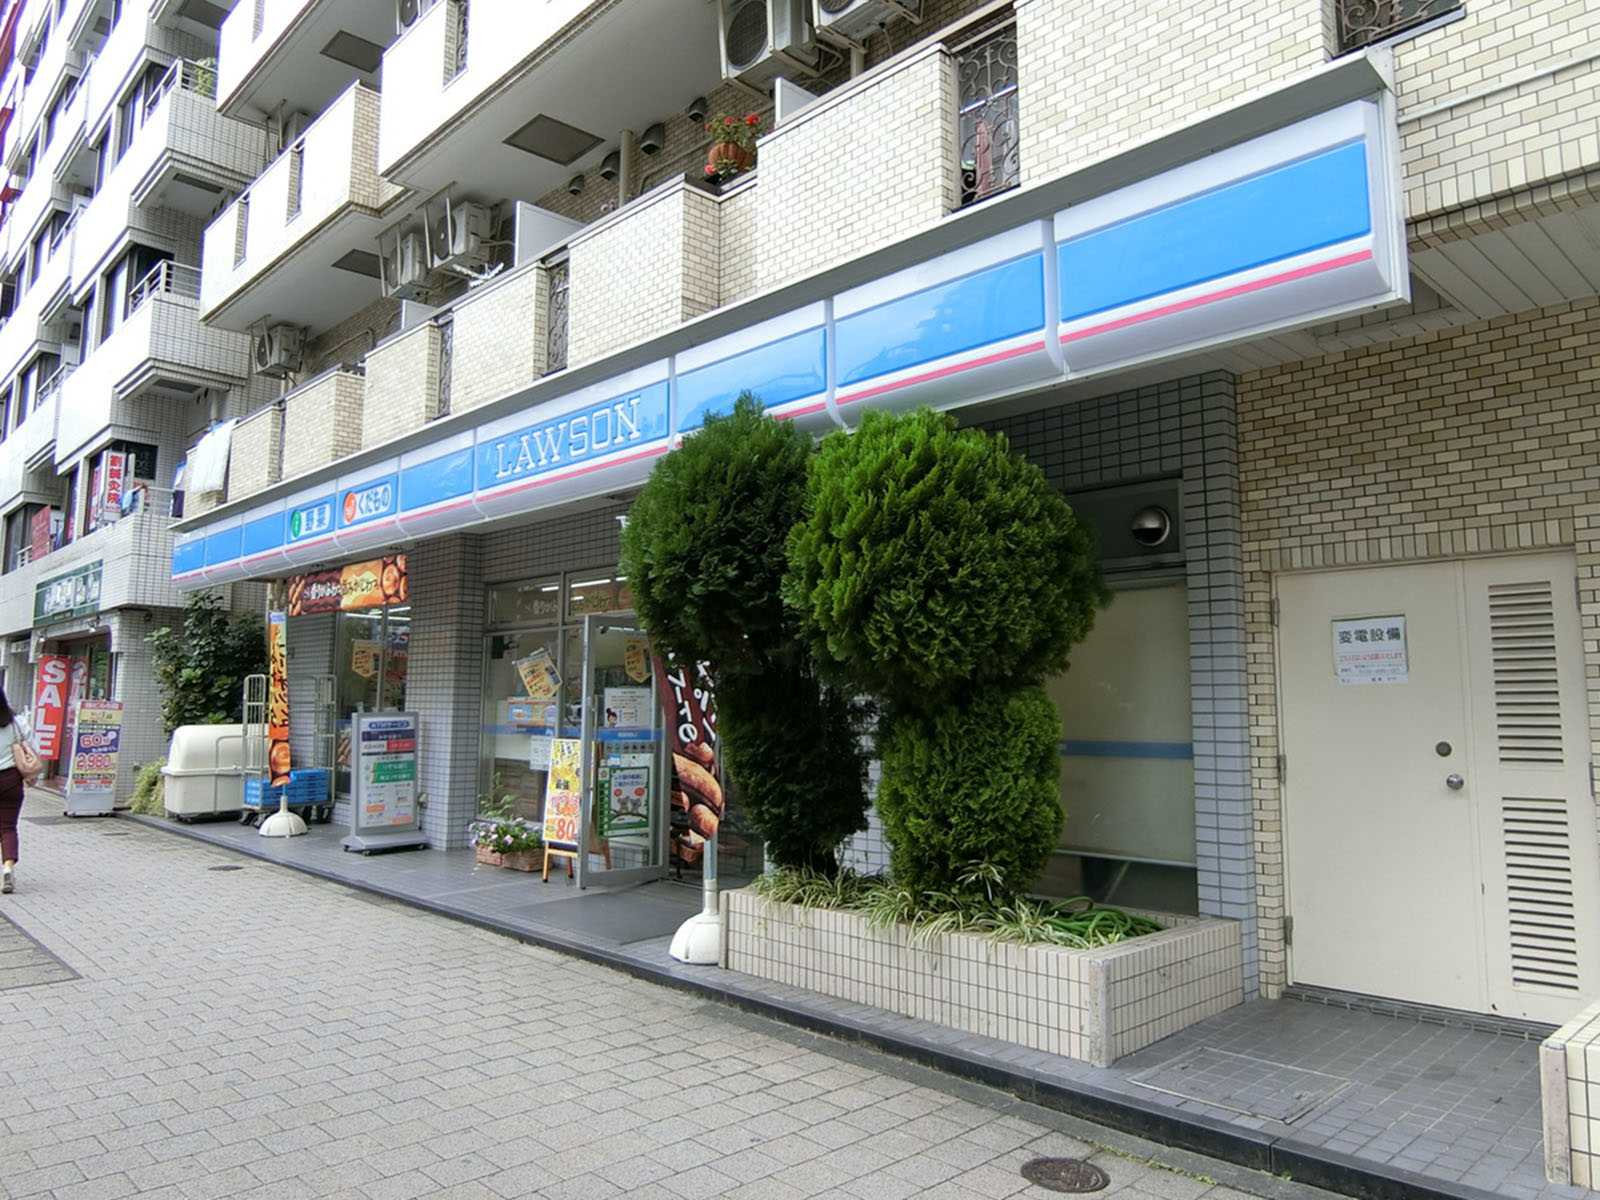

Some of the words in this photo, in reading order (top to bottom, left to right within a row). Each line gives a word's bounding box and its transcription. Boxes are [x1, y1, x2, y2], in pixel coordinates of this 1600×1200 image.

[496, 398, 641, 478] LAWSON
[359, 486, 390, 515] くだもの
[305, 505, 327, 531] 野菜
[1338, 627, 1401, 644] 変電設備
[36, 660, 67, 756] SALE
